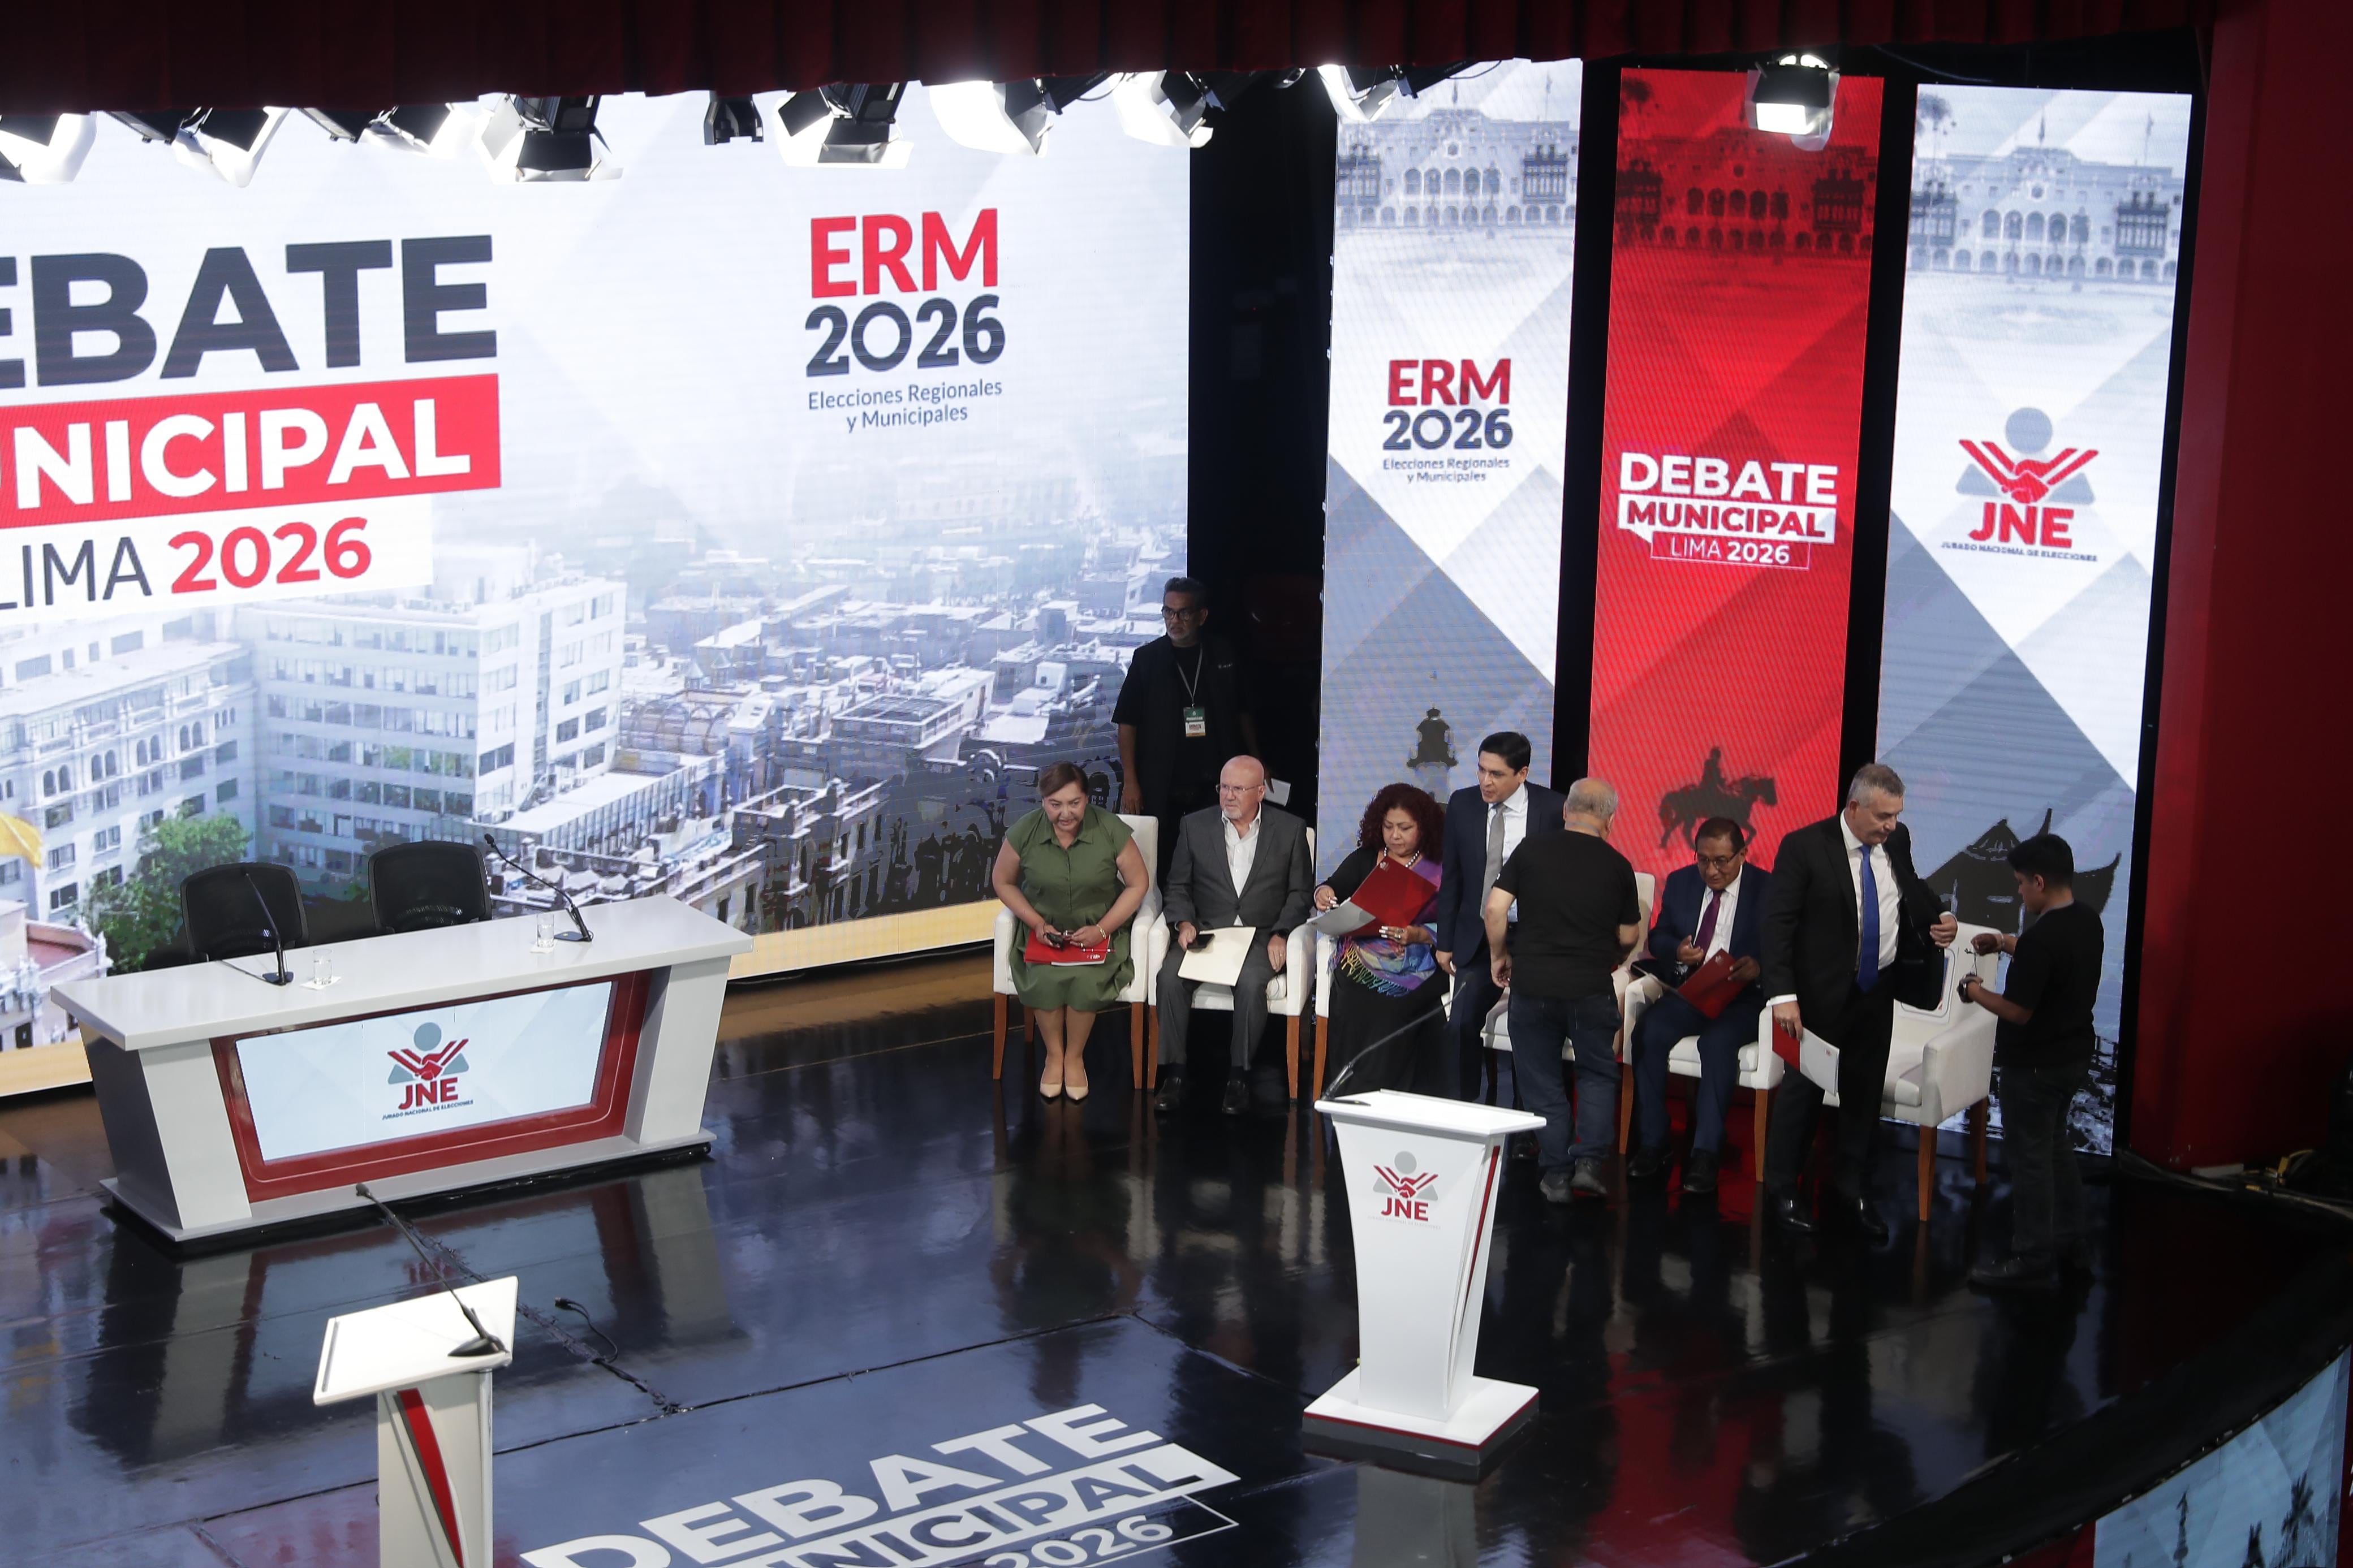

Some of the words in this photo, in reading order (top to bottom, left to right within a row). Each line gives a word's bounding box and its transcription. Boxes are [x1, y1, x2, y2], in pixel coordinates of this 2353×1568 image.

[811, 208, 998, 298] ERM
[0, 235, 498, 388] BATE
[805, 293, 1006, 377] 2026
[809, 389, 903, 410] Elecciones
[908, 379, 1002, 404] Regionales
[1388, 358, 1511, 405] ERM
[847, 417, 857, 433] y
[862, 405, 968, 428] Municipales
[1383, 409, 1513, 450] 2026
[0, 399, 471, 509] NICIPAL
[1383, 458, 1444, 470] Elecciones
[1446, 457, 1510, 470] Regionales
[1407, 474, 1413, 483] y
[1416, 470, 1486, 482] Municipales
[1620, 452, 1838, 504] DEBATE
[1627, 500, 1825, 538] MUNICIPAL
[1968, 502, 2074, 548] JNE
[167, 517, 372, 594] 2026
[1671, 537, 1721, 558] LIMA
[1727, 541, 1790, 564] 2026
[398, 1077, 458, 1109] JNE
[1381, 1197, 1429, 1221] JNE
[766, 1463, 1204, 1568] NICIPAL
